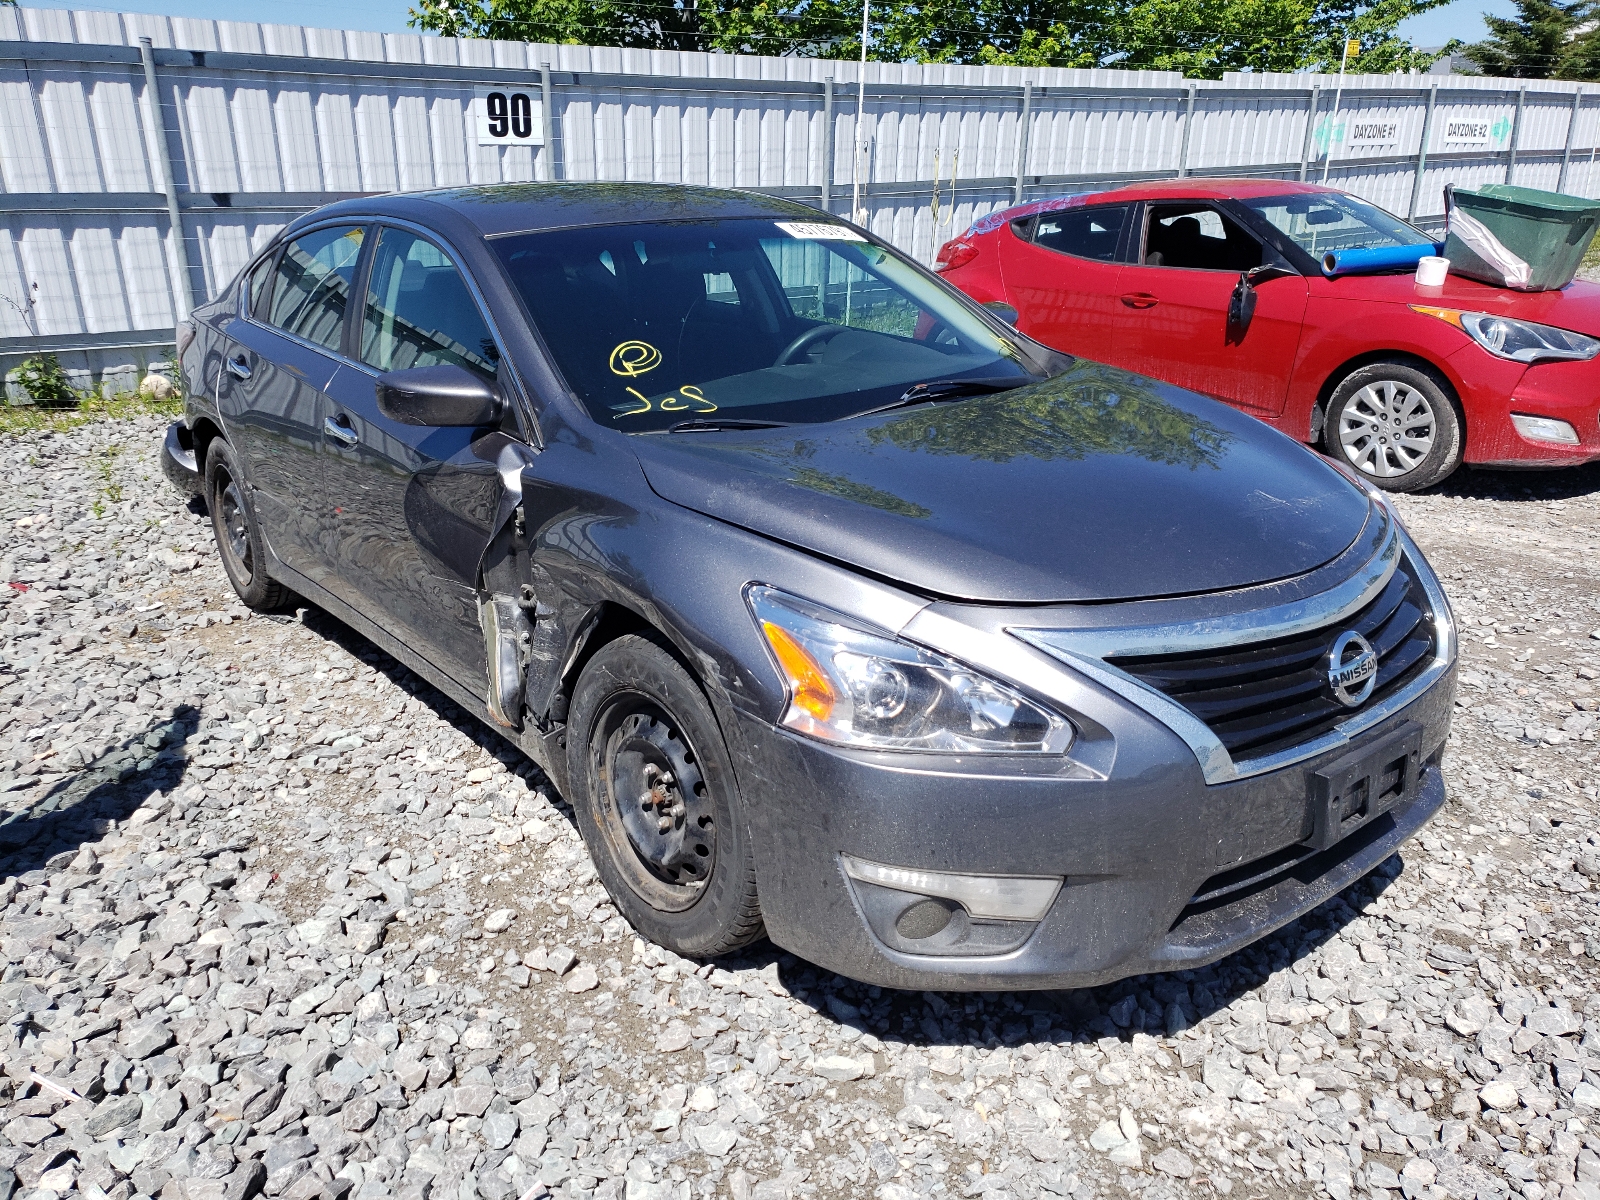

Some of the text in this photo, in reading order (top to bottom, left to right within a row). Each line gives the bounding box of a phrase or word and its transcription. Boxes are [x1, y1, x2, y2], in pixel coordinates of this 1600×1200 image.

[487, 92, 532, 138] 90
[1353, 124, 1397, 139] DAYZONE #1
[1447, 123, 1488, 138] DAYZONE #2
[1339, 659, 1377, 684] NISSAN
